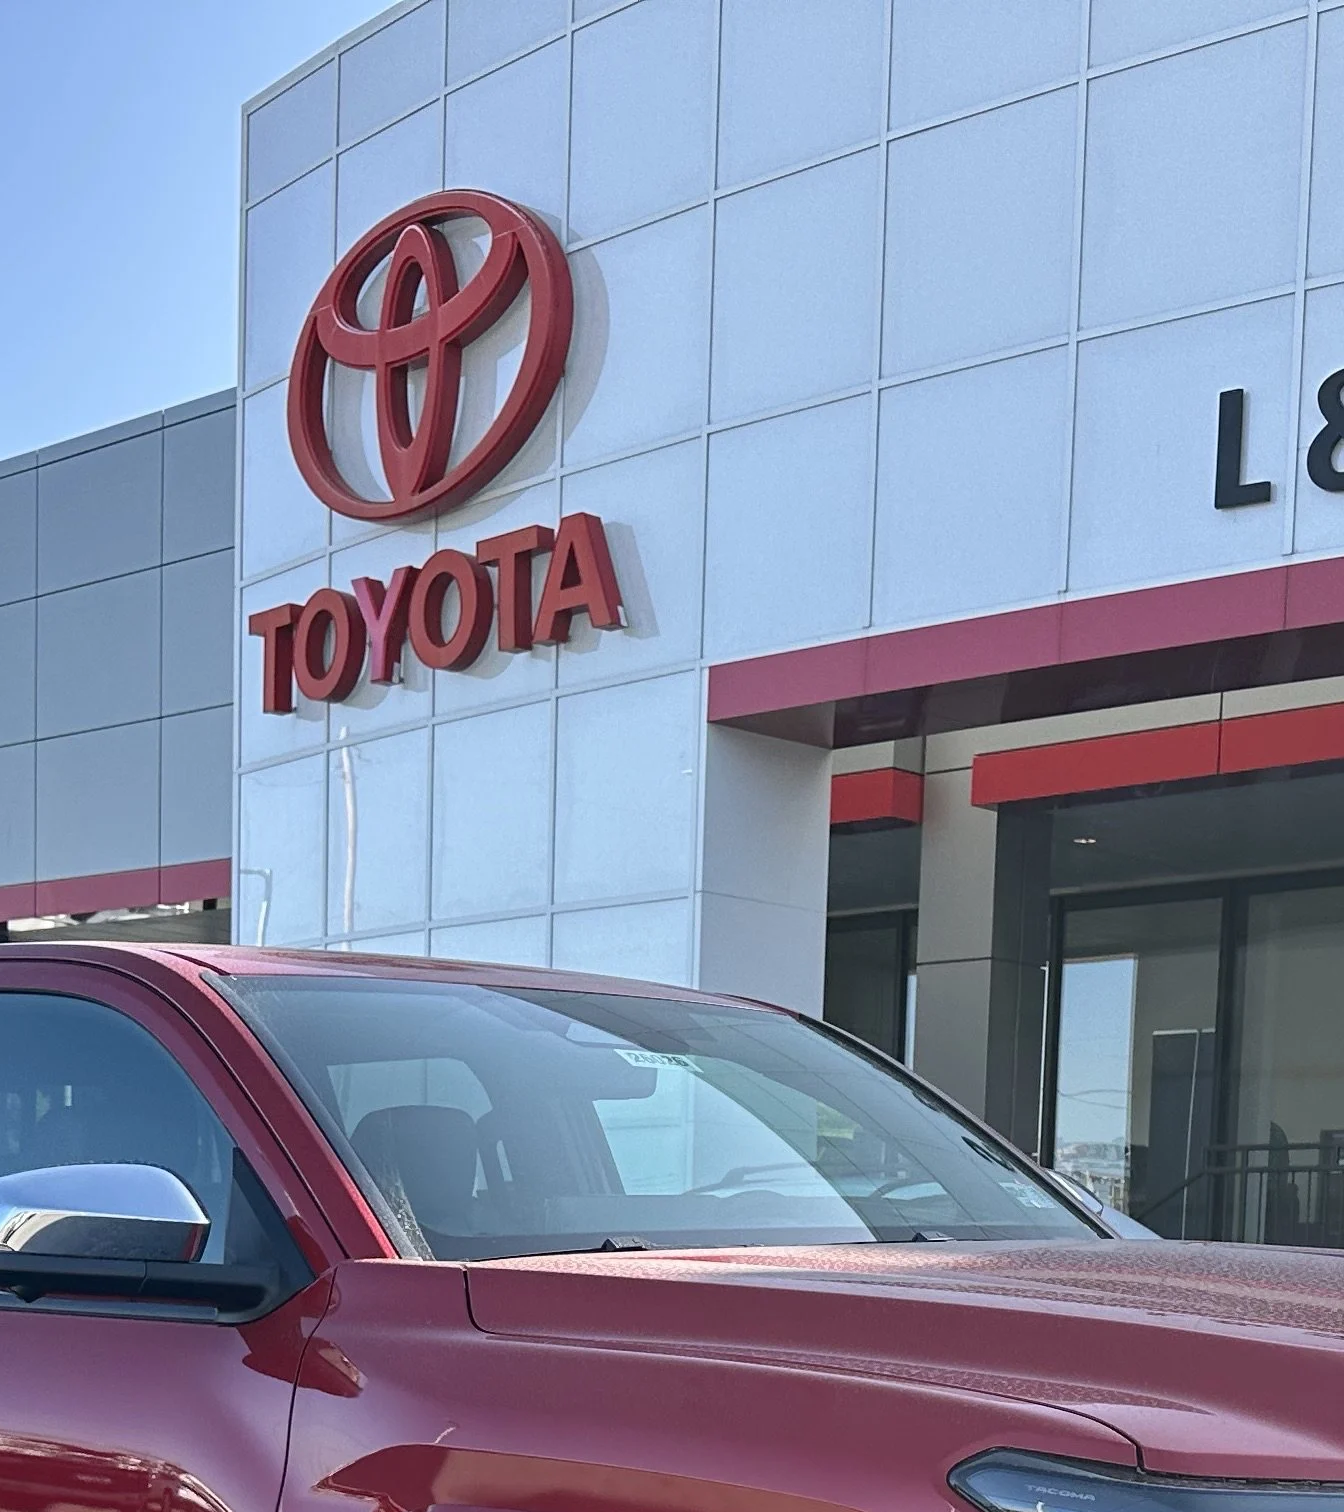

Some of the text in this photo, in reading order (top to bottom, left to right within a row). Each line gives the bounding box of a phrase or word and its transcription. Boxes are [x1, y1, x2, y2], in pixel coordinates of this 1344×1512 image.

[1214, 388, 1271, 509] L
[249, 512, 628, 714] TOYOTA
[1025, 1484, 1096, 1501] TACOMA
